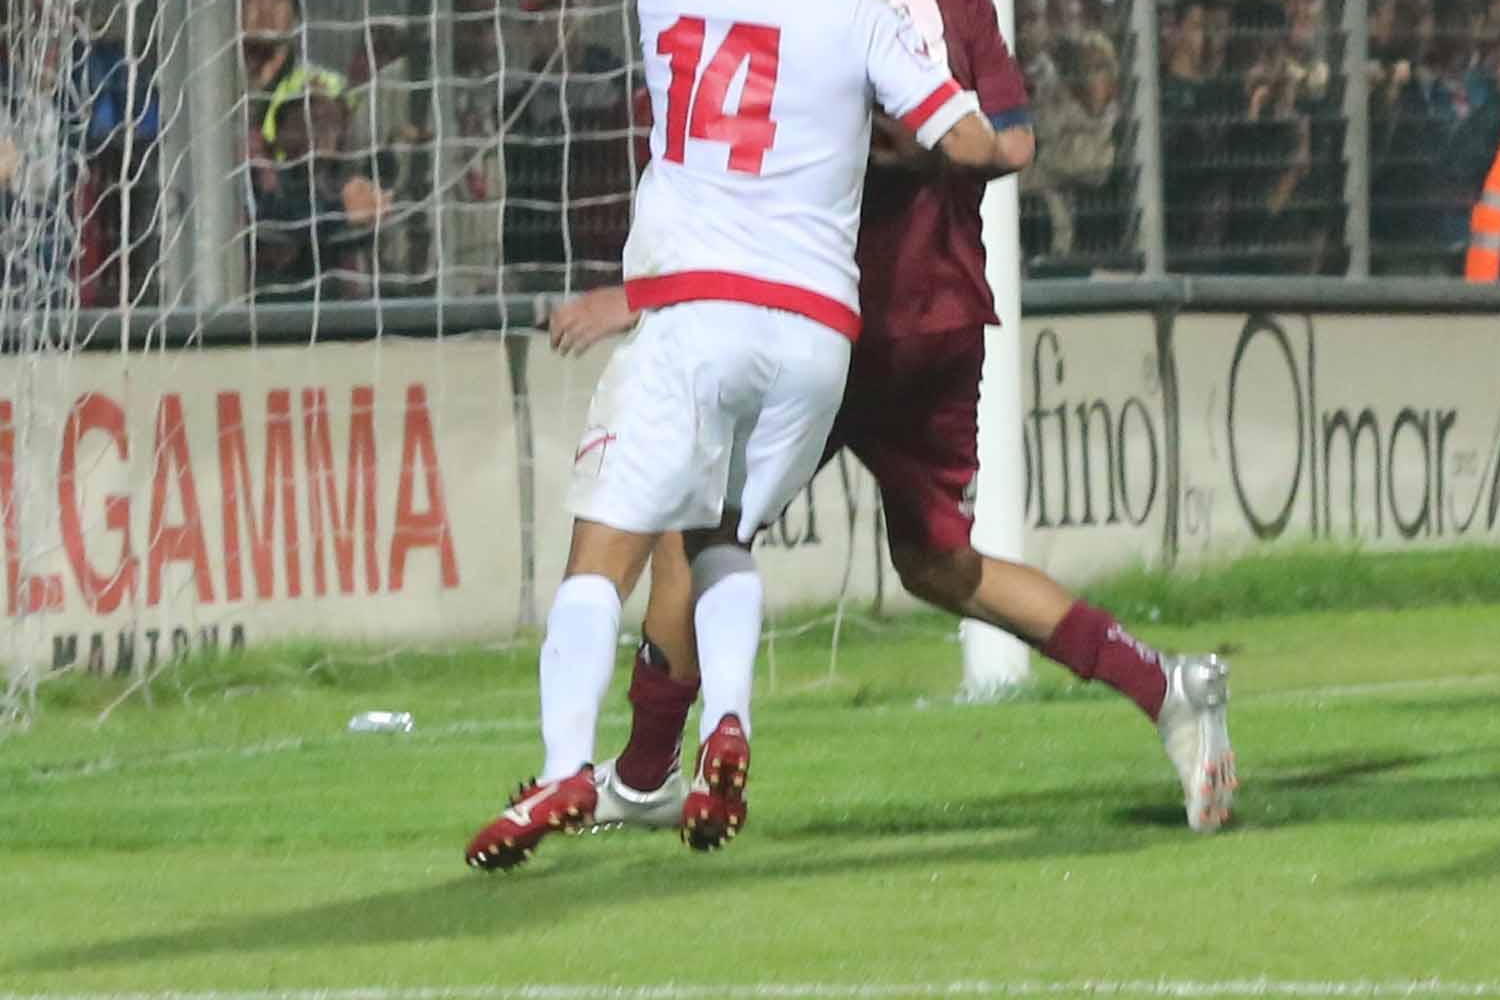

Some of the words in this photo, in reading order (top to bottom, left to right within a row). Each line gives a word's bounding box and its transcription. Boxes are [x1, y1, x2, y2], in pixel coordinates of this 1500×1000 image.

[656, 15, 781, 175] 14
[1024, 327, 1158, 529] fino
[1227, 313, 1457, 541] Olmar
